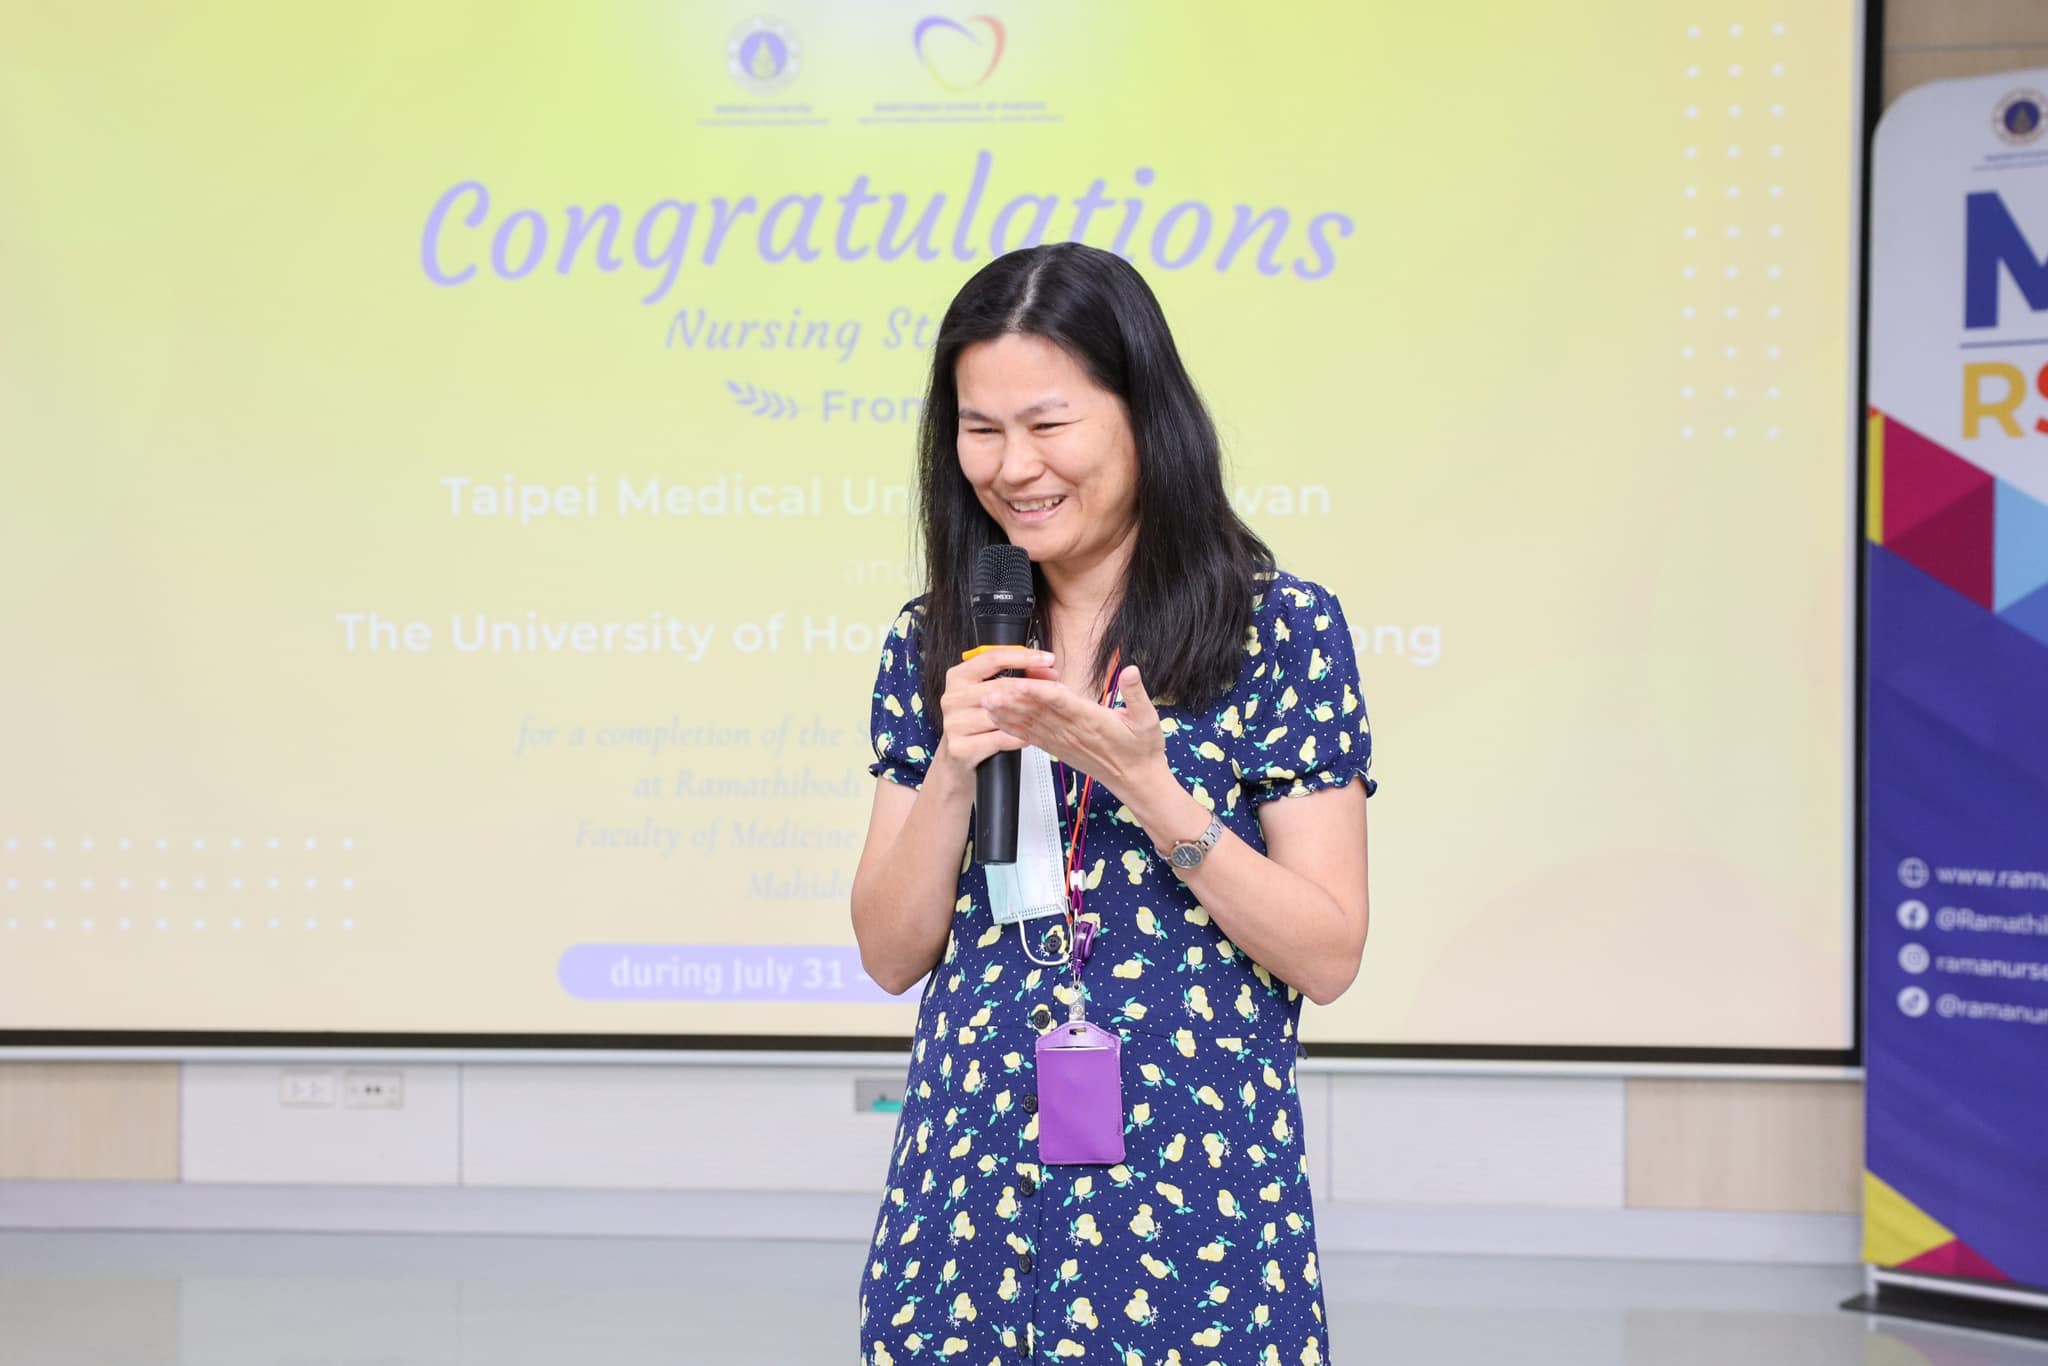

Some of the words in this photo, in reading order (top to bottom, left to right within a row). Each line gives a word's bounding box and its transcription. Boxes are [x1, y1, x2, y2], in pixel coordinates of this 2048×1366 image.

[420, 151, 1355, 305] Congratulations
[665, 307, 862, 364] Nursing
[440, 474, 599, 525] Taipei
[617, 474, 823, 516] Medical
[1232, 485, 1331, 517] wan
[336, 610, 432, 653] The
[452, 610, 715, 662] University
[732, 611, 785, 653] of
[1351, 623, 1441, 665] ong
[514, 711, 559, 757] for
[568, 727, 586, 748] a
[595, 713, 751, 757] completion
[760, 713, 792, 758] of
[801, 716, 843, 748] the
[632, 775, 665, 799] at
[676, 767, 862, 799] Ramathibodi
[576, 815, 682, 860] Faculty
[690, 816, 722, 858] of
[730, 816, 857, 849] Medicine
[610, 955, 723, 995] during
[732, 957, 794, 995] July
[802, 957, 845, 989] 31
